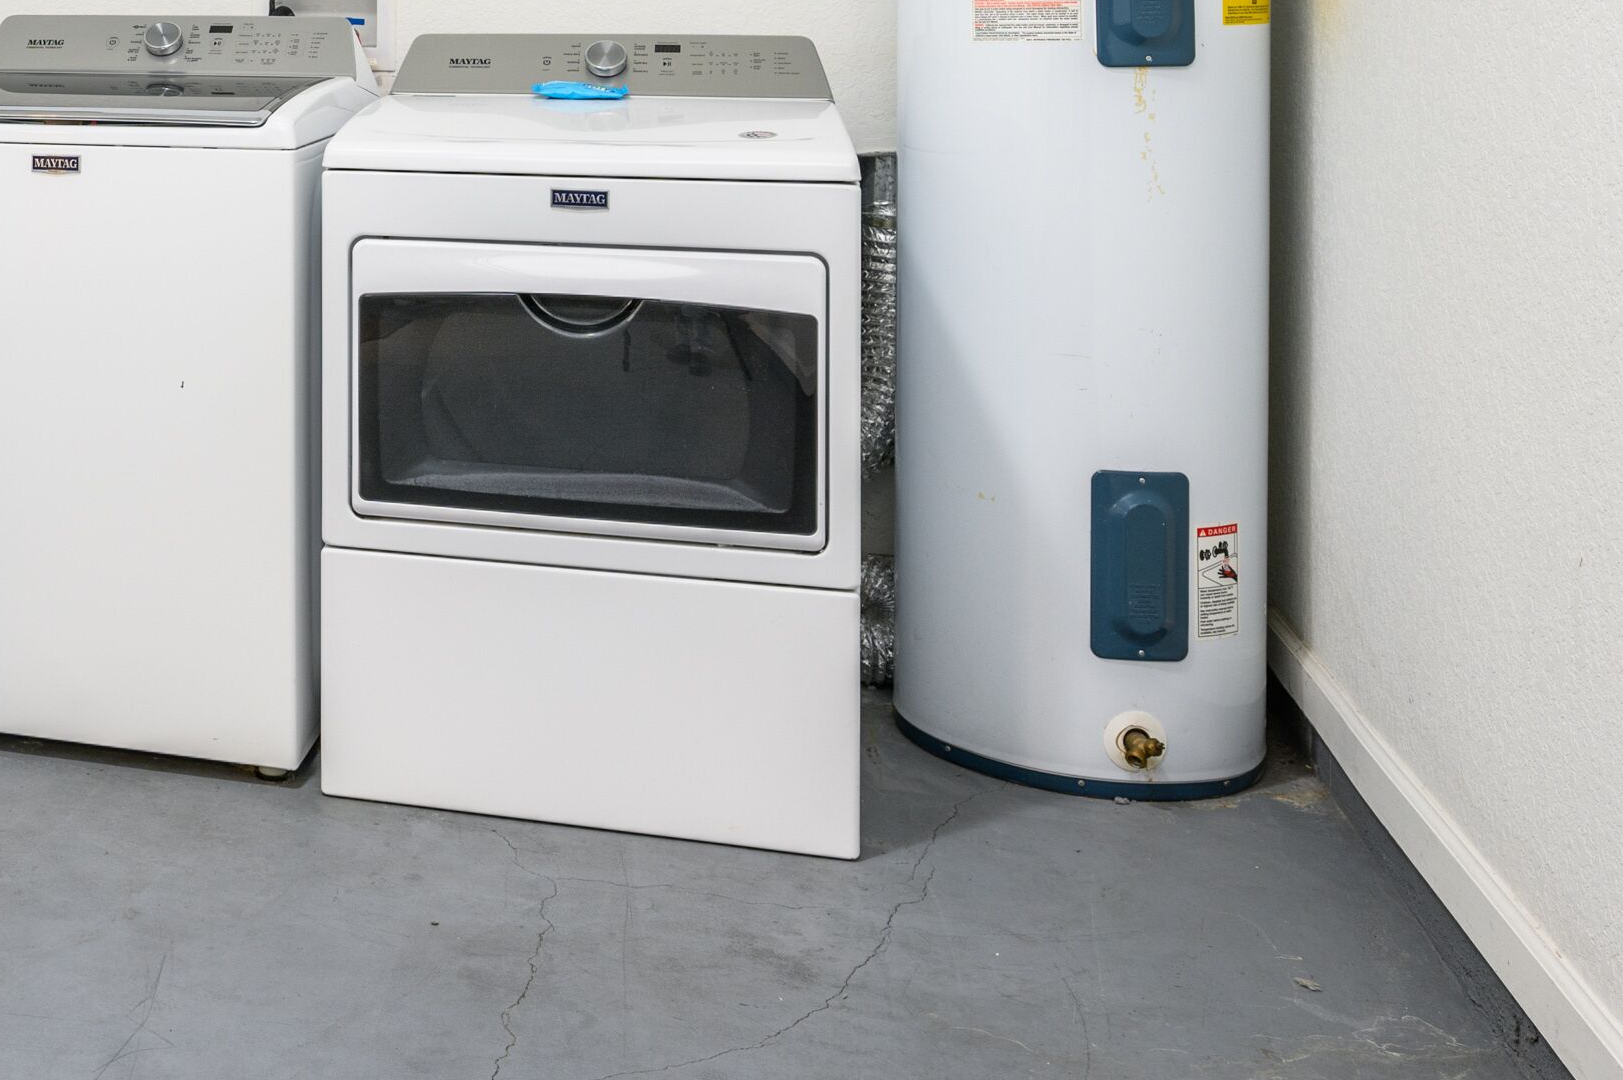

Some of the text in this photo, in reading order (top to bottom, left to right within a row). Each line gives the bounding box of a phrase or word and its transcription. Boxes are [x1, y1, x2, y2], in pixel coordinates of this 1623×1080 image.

[34, 157, 78, 169] MAYTAG
[554, 192, 606, 205] MAYTAG
[1208, 525, 1236, 536] DANGER
